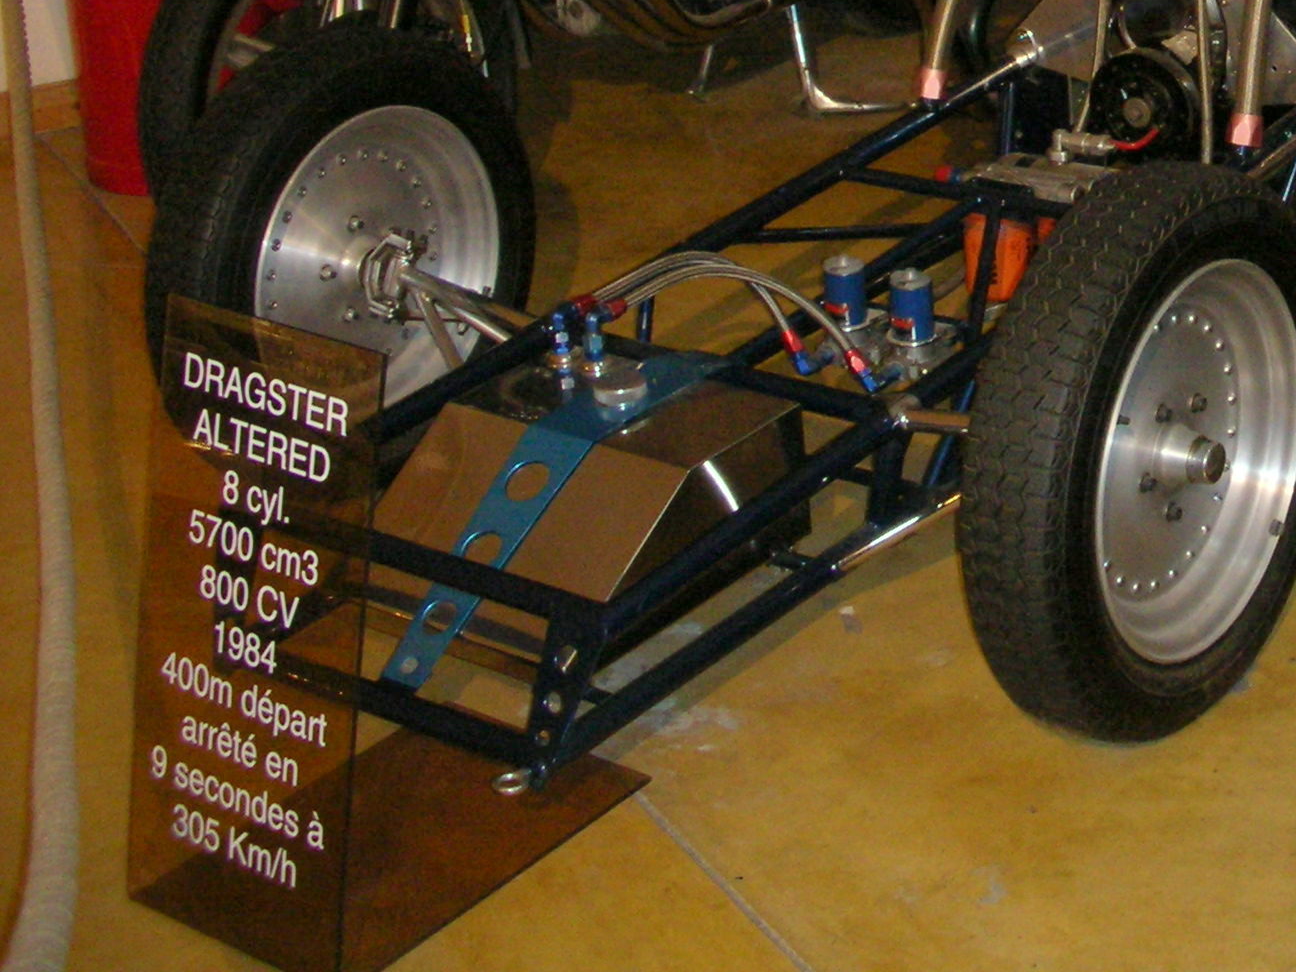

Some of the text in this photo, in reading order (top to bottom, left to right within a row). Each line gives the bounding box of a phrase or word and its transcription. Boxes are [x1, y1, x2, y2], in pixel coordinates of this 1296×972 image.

[183, 352, 349, 437] DRAGSTER
[192, 408, 332, 483] ALTERED
[222, 469, 290, 526] 8 cyl.
[188, 508, 319, 586] 5700 cm3
[199, 563, 300, 629] 800 CV
[214, 620, 278, 674] 1984
[161, 651, 328, 747] 400m départ
[181, 715, 299, 788] arrêté en
[150, 744, 325, 851] 9 secondes à
[172, 803, 298, 888] 305 Km/h
